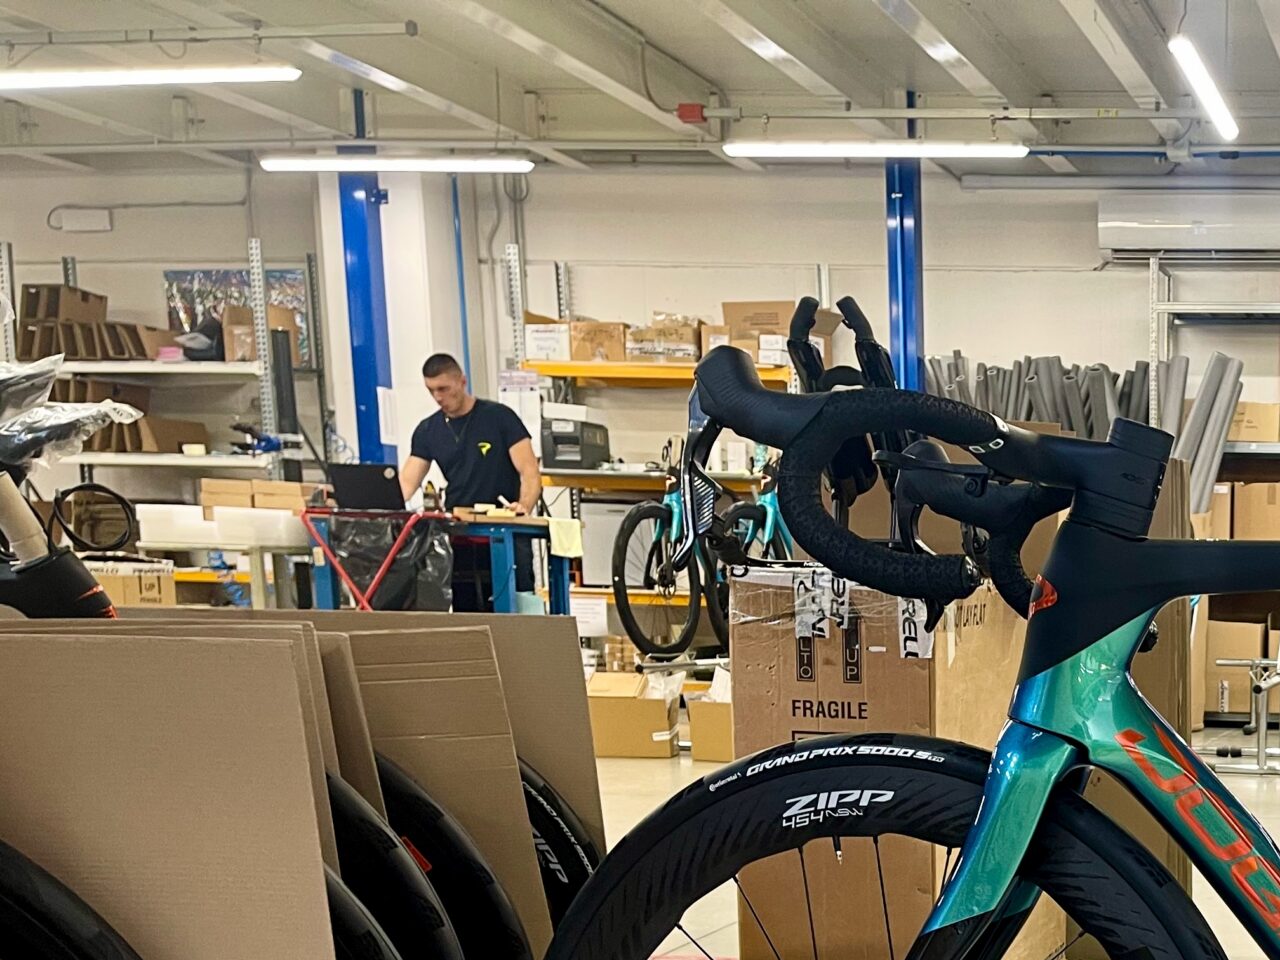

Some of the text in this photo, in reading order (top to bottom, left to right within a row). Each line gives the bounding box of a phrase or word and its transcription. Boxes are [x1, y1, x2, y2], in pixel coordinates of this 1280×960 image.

[800, 639, 812, 678] LTO
[846, 648, 858, 680] UP
[792, 700, 868, 720] FRAGILE
[746, 751, 809, 777] GRAND
[809, 746, 858, 759] PRIX
[856, 746, 914, 758] 5000
[782, 790, 895, 818] ZIPP
[782, 810, 824, 829] 454
